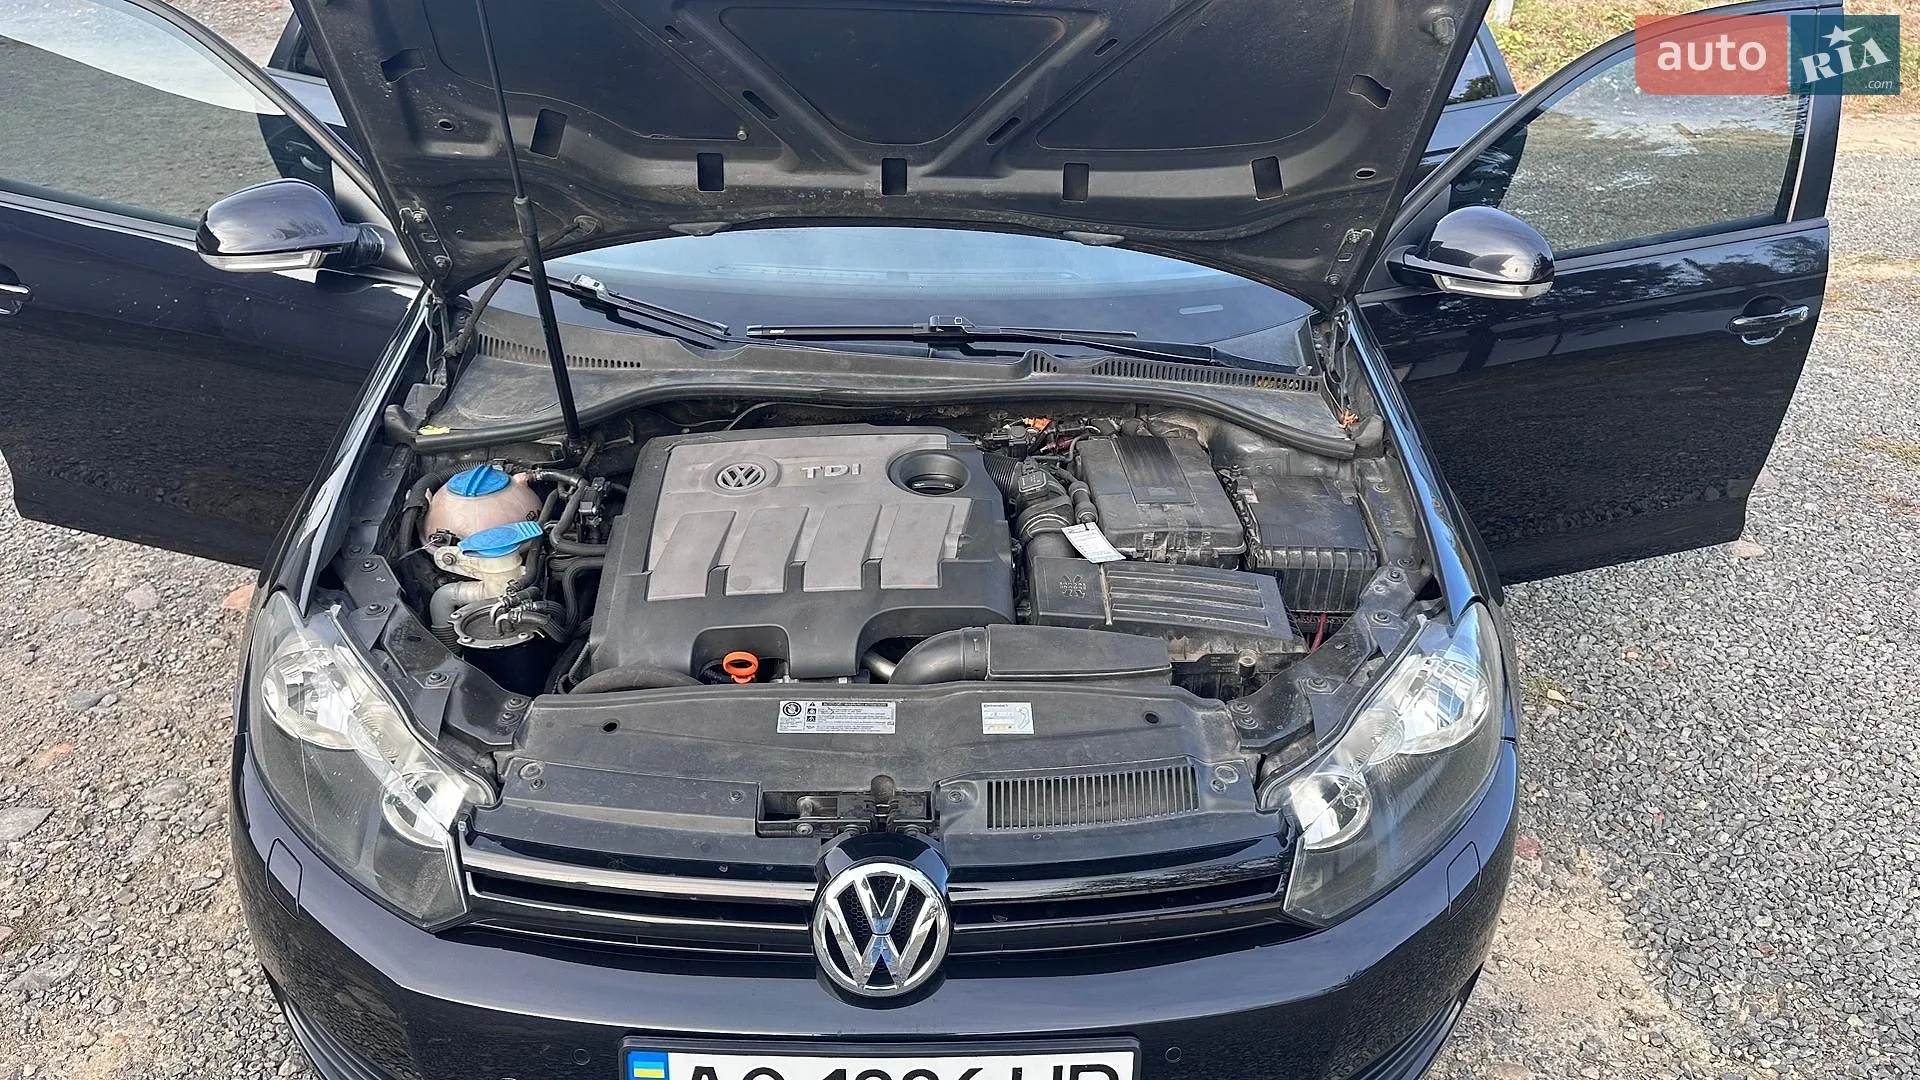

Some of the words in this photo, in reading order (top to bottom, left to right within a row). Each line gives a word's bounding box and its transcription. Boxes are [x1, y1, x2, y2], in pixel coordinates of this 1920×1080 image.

[716, 462, 766, 491] VW
[801, 463, 861, 479] TDI
[813, 862, 950, 997] VW
